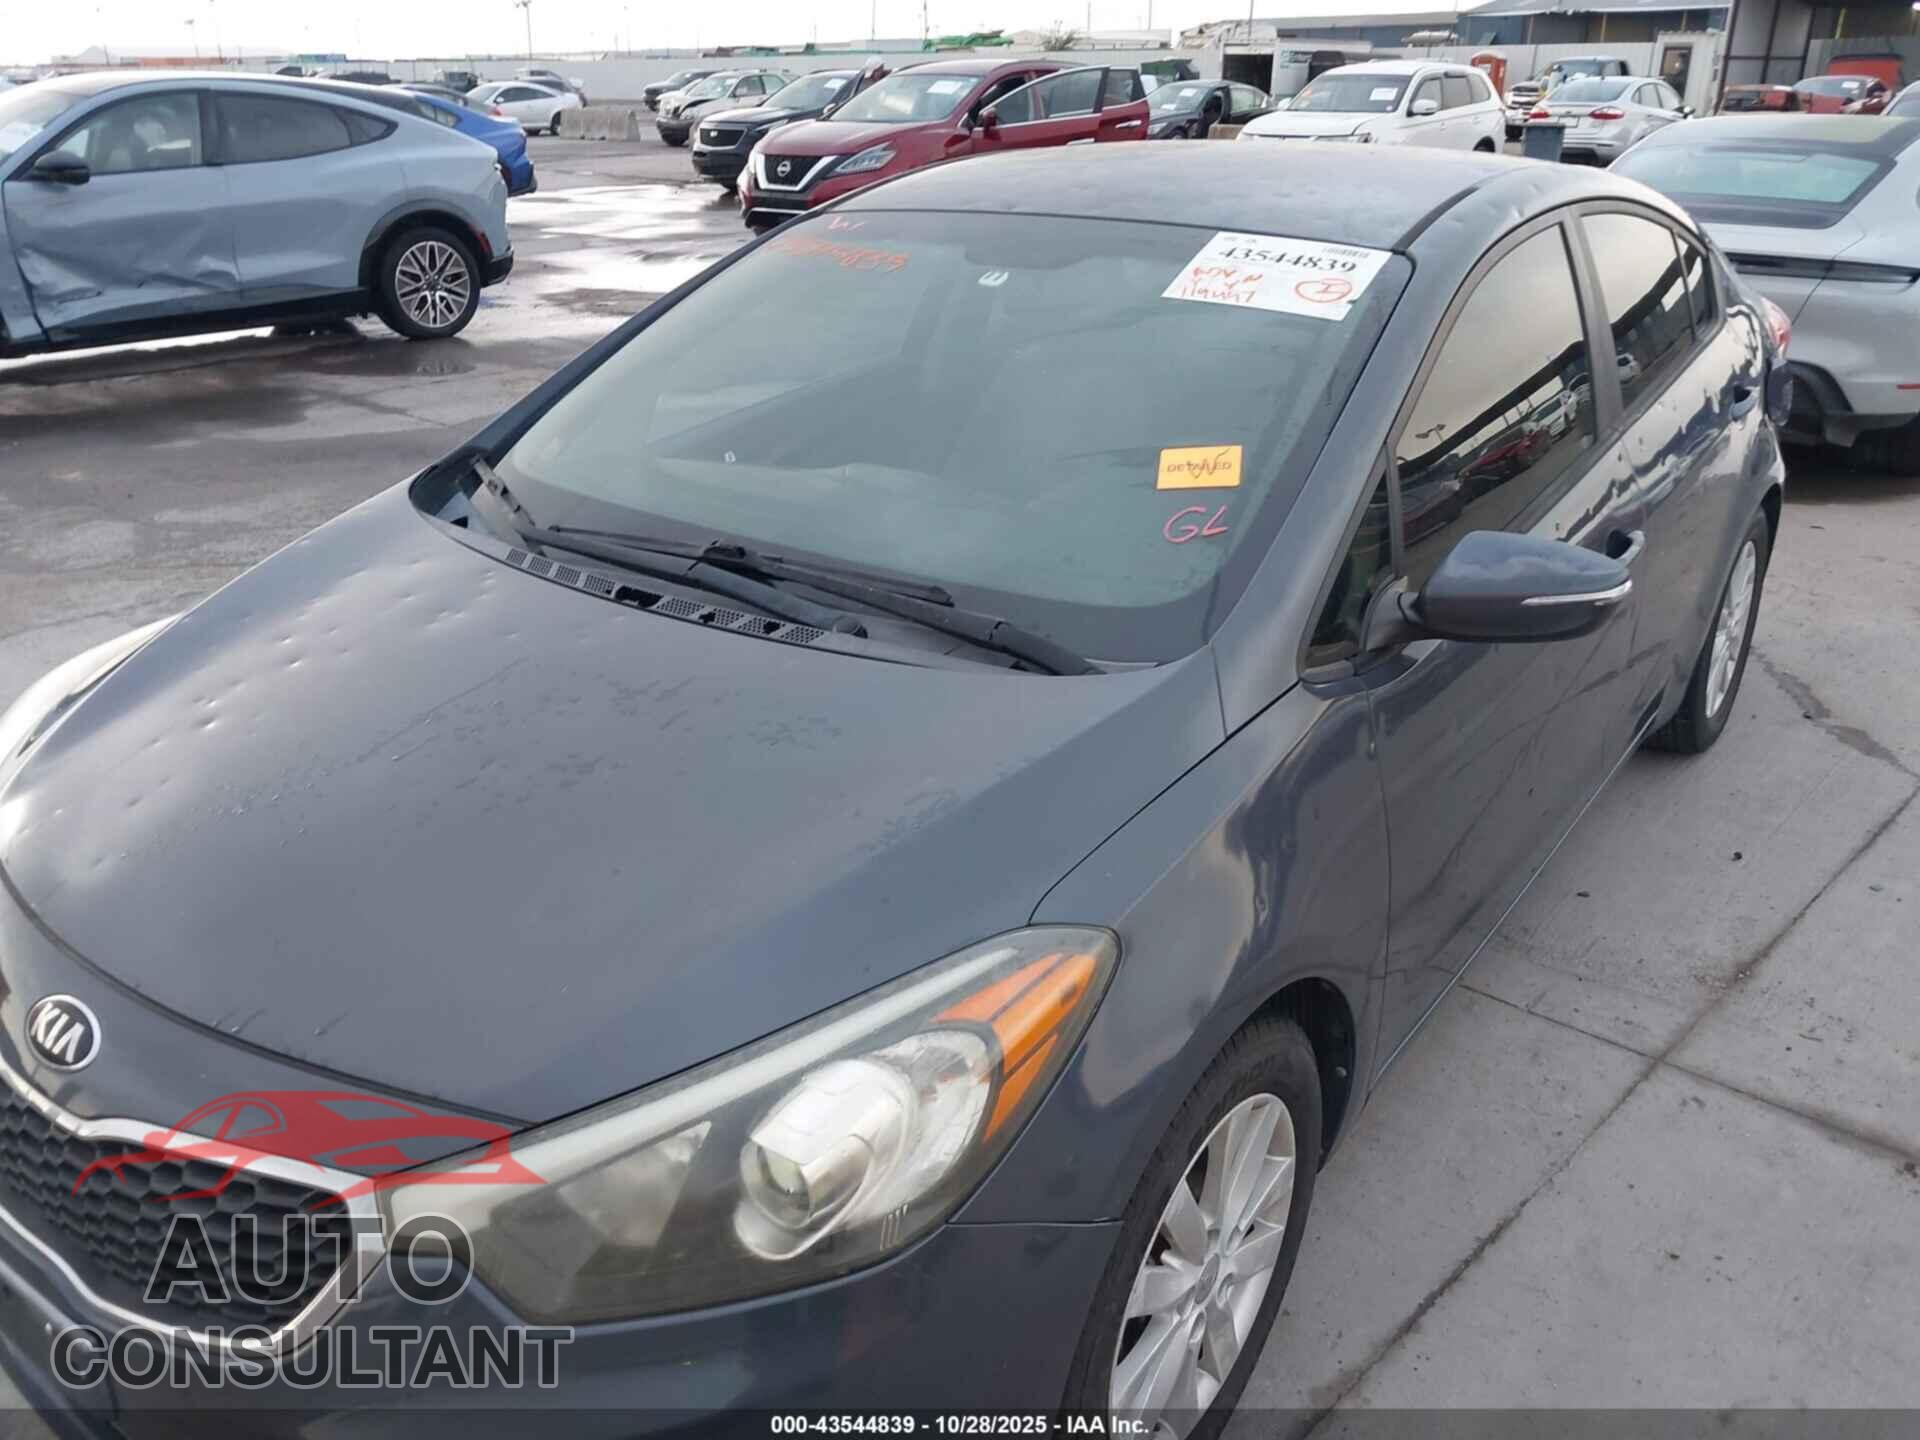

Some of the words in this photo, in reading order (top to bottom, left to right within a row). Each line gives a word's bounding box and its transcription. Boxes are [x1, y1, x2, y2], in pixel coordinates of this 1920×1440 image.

[1218, 246, 1358, 273] 43544839
[1163, 504, 1229, 543] GL
[29, 1001, 86, 1064] KIA
